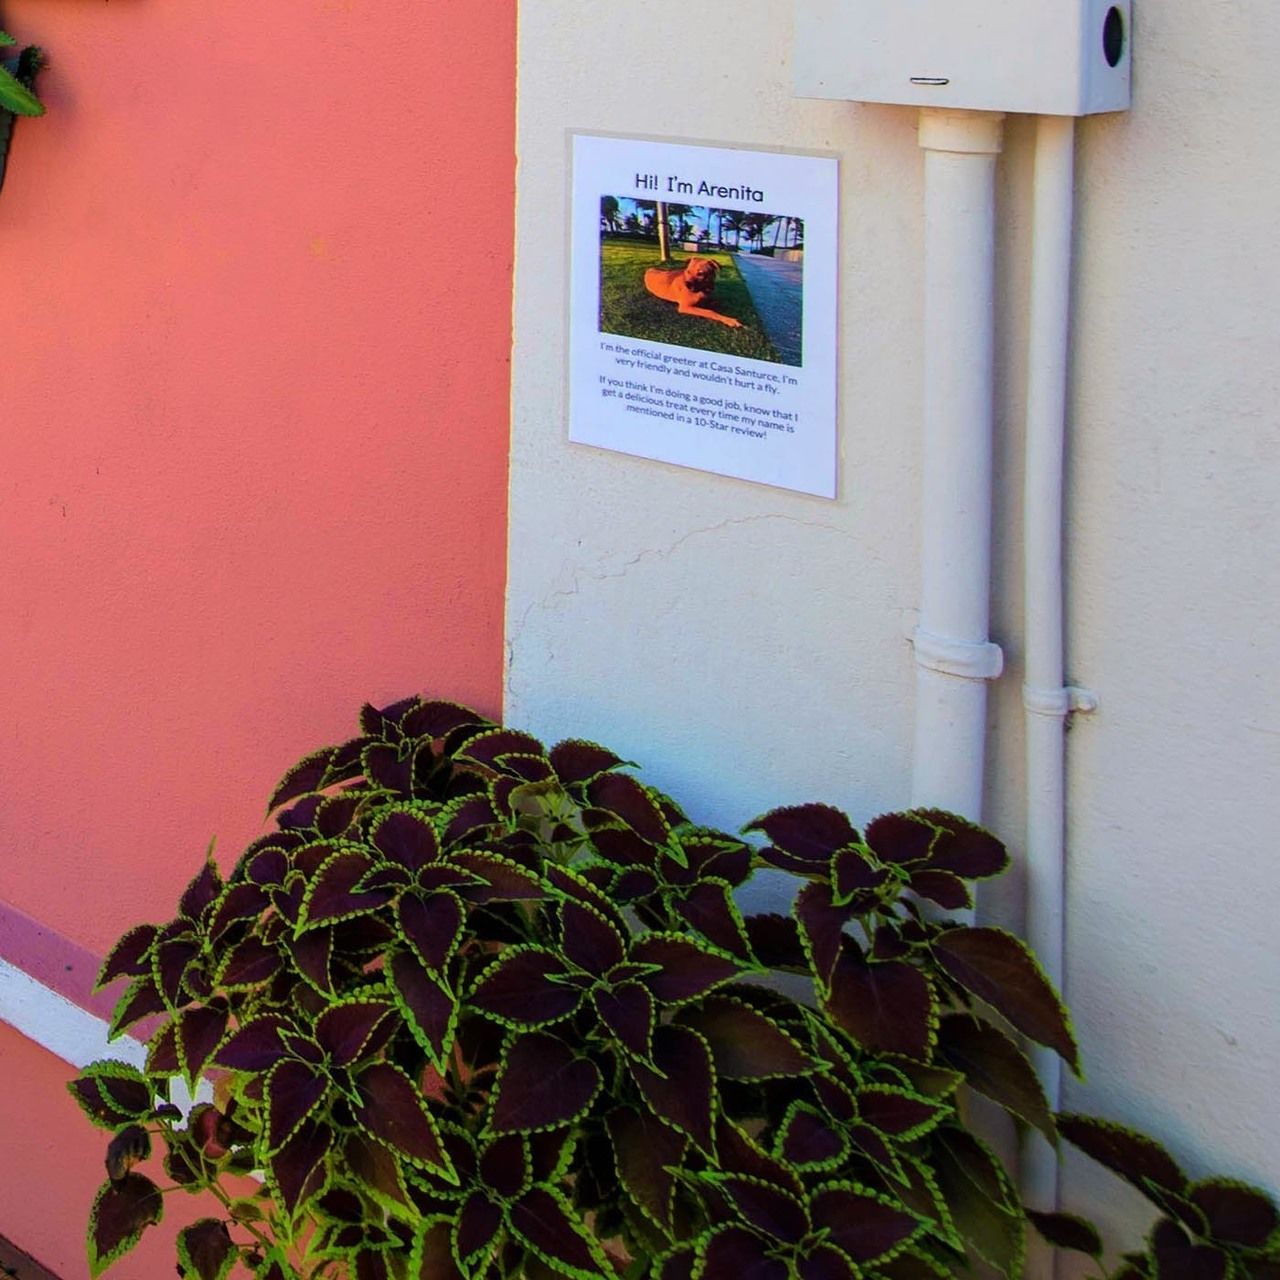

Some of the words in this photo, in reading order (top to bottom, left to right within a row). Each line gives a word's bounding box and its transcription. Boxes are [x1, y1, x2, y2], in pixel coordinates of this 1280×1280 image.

[635, 173, 658, 190] Hi!
[667, 176, 693, 194] I'm
[697, 181, 764, 202] Arenita
[600, 342, 614, 351] I'm
[615, 345, 630, 355] the
[631, 349, 662, 360] official
[663, 355, 697, 367] greeter
[698, 361, 708, 369] at
[710, 362, 733, 374] Casa
[782, 375, 798, 386] I'm
[615, 358, 636, 369] very
[637, 360, 672, 375] friendly
[673, 367, 691, 377] and
[692, 371, 733, 386] wouldn't
[734, 377, 756, 390] hurt
[764, 384, 781, 395] fly.
[599, 375, 606, 384] If
[608, 378, 624, 388] you
[625, 380, 648, 393] think
[649, 385, 664, 395] I'm
[665, 388, 692, 402] doing
[699, 396, 723, 408] good
[743, 403, 771, 416] know
[772, 409, 793, 421] that
[602, 388, 617, 398] get
[625, 392, 664, 407] delicious
[665, 400, 689, 412] treat
[690, 407, 716, 419] every
[718, 411, 740, 422] time
[741, 416, 756, 427] my
[757, 420, 785, 432] name
[786, 423, 796, 434] is
[626, 404, 675, 420] mentioned
[676, 413, 686, 423] in
[695, 417, 729, 431] 10-Star
[730, 426, 768, 440] review!
